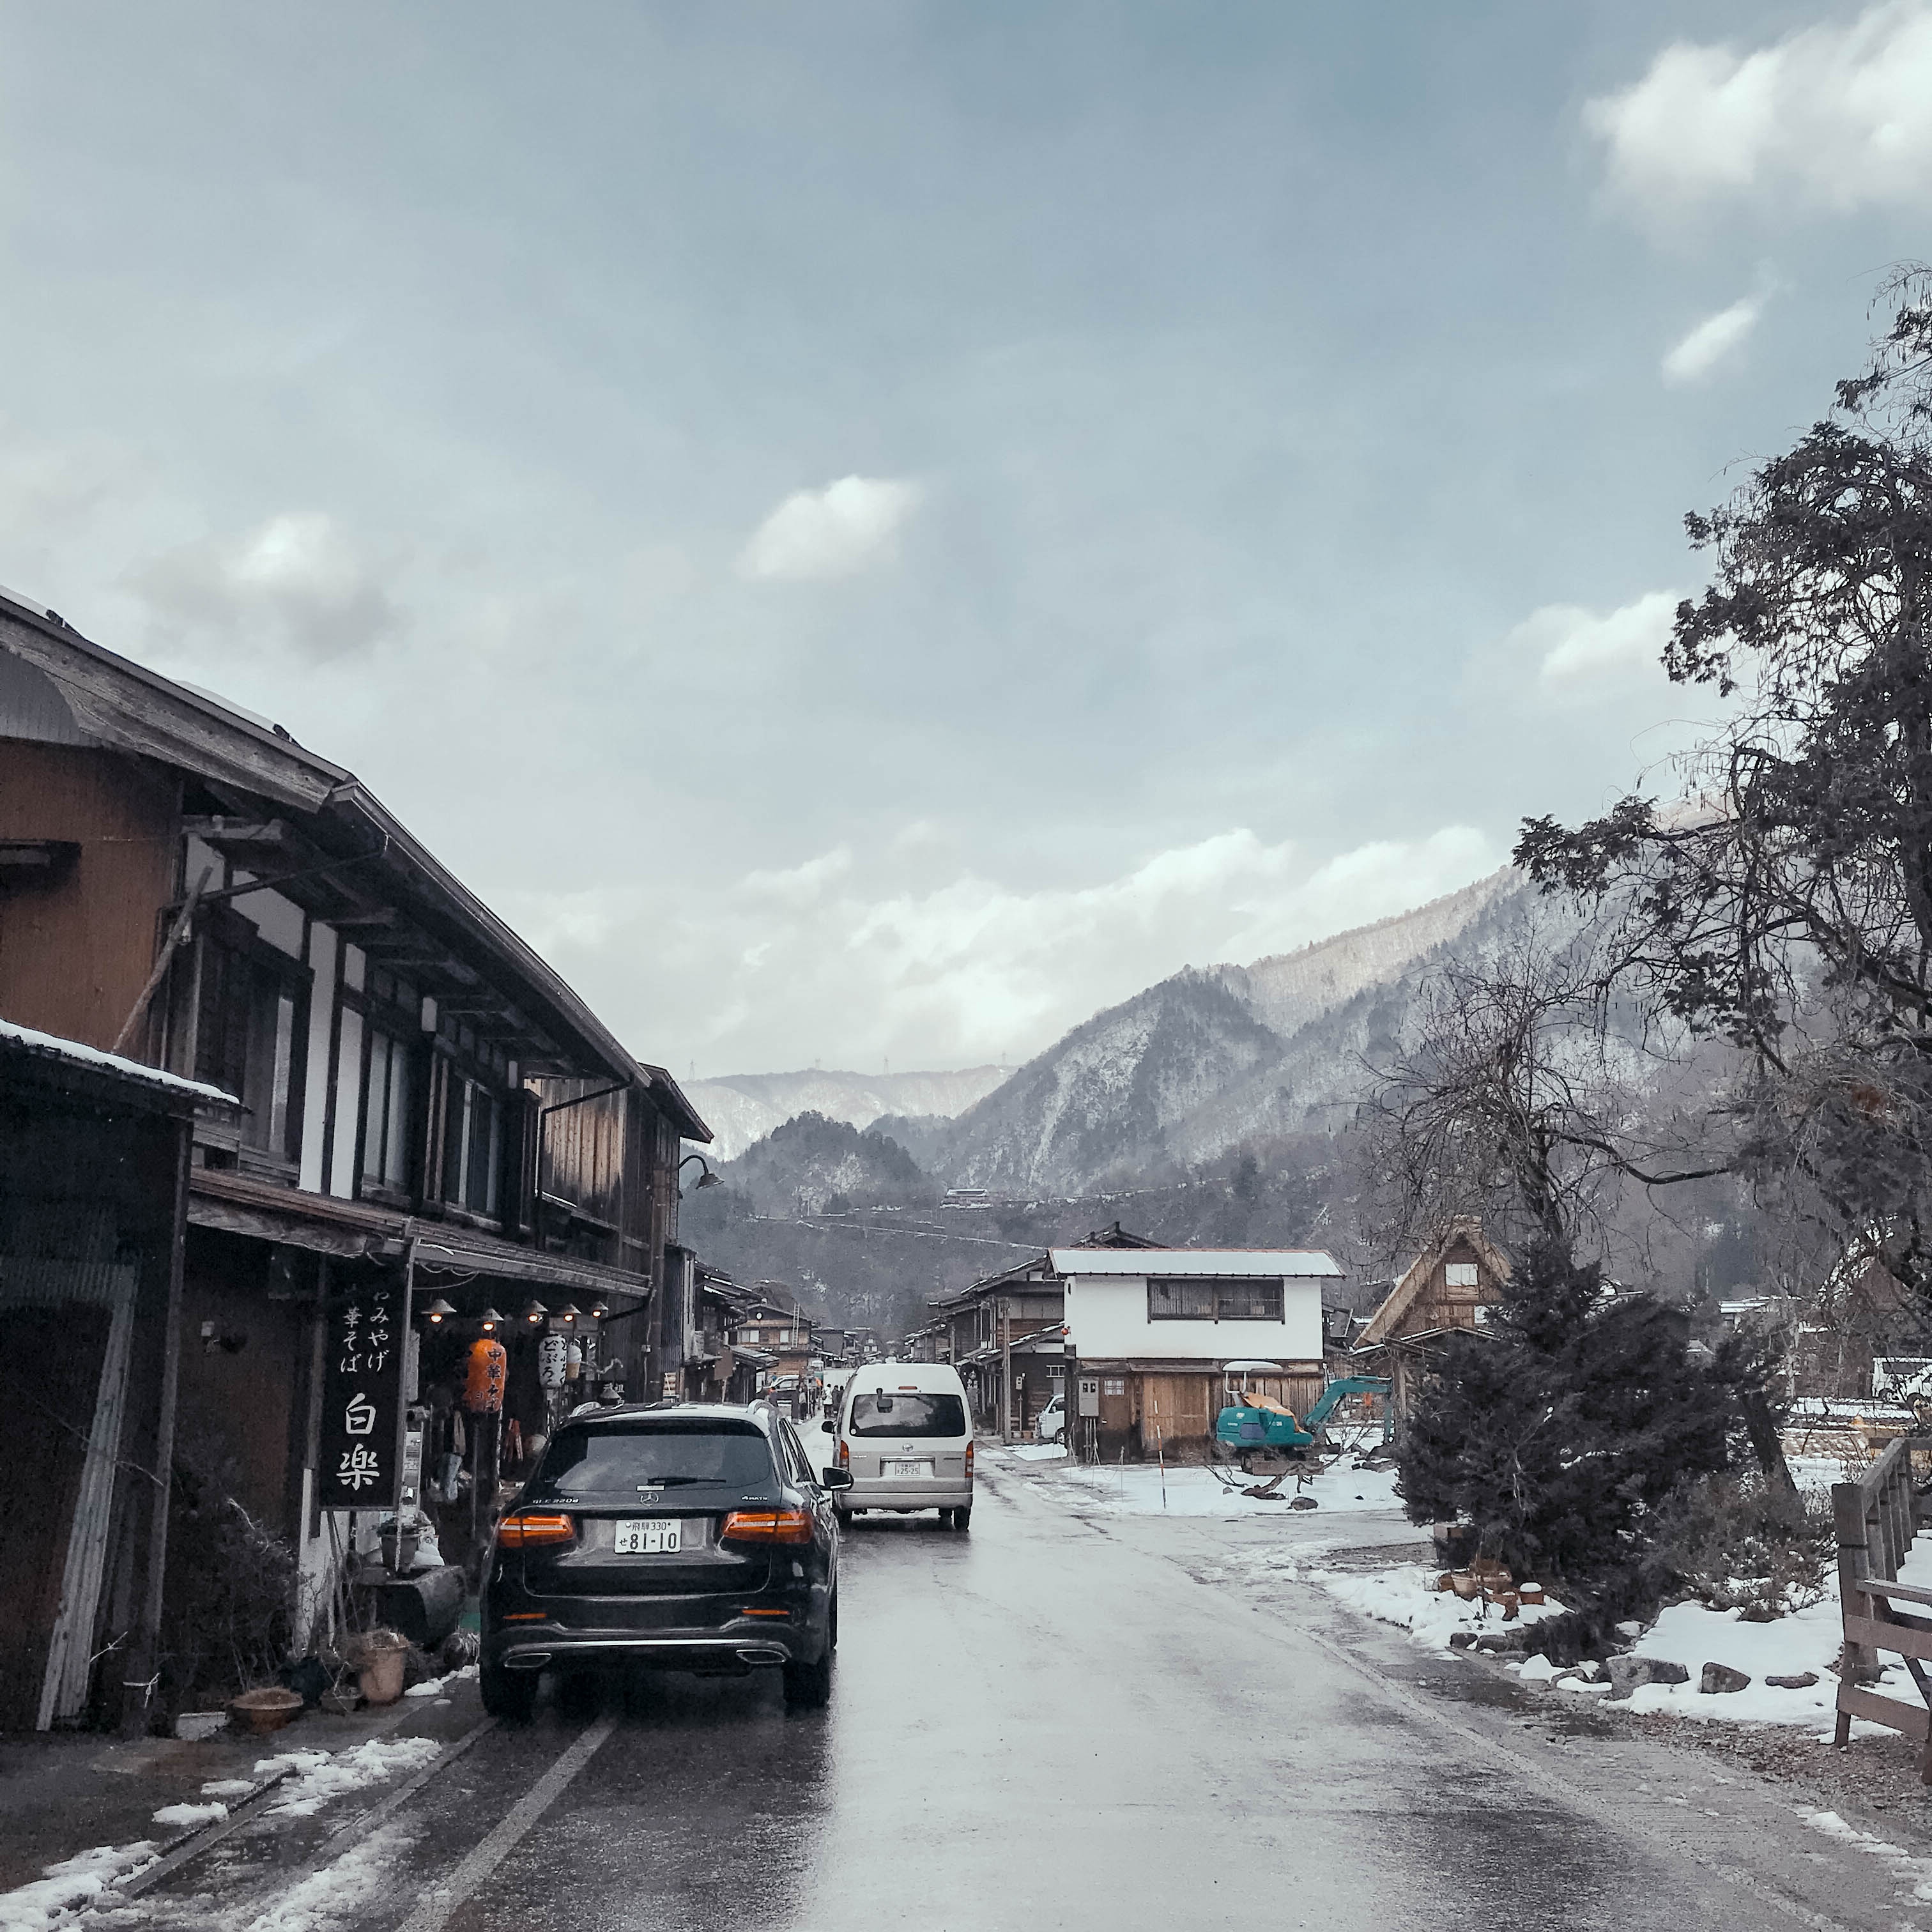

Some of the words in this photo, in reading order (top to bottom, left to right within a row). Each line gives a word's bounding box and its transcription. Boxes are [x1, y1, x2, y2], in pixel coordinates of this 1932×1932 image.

[341, 1284, 362, 1373] 華そば
[336, 1393, 379, 1491] 白楽
[630, 1533, 677, 1550] 81-10
